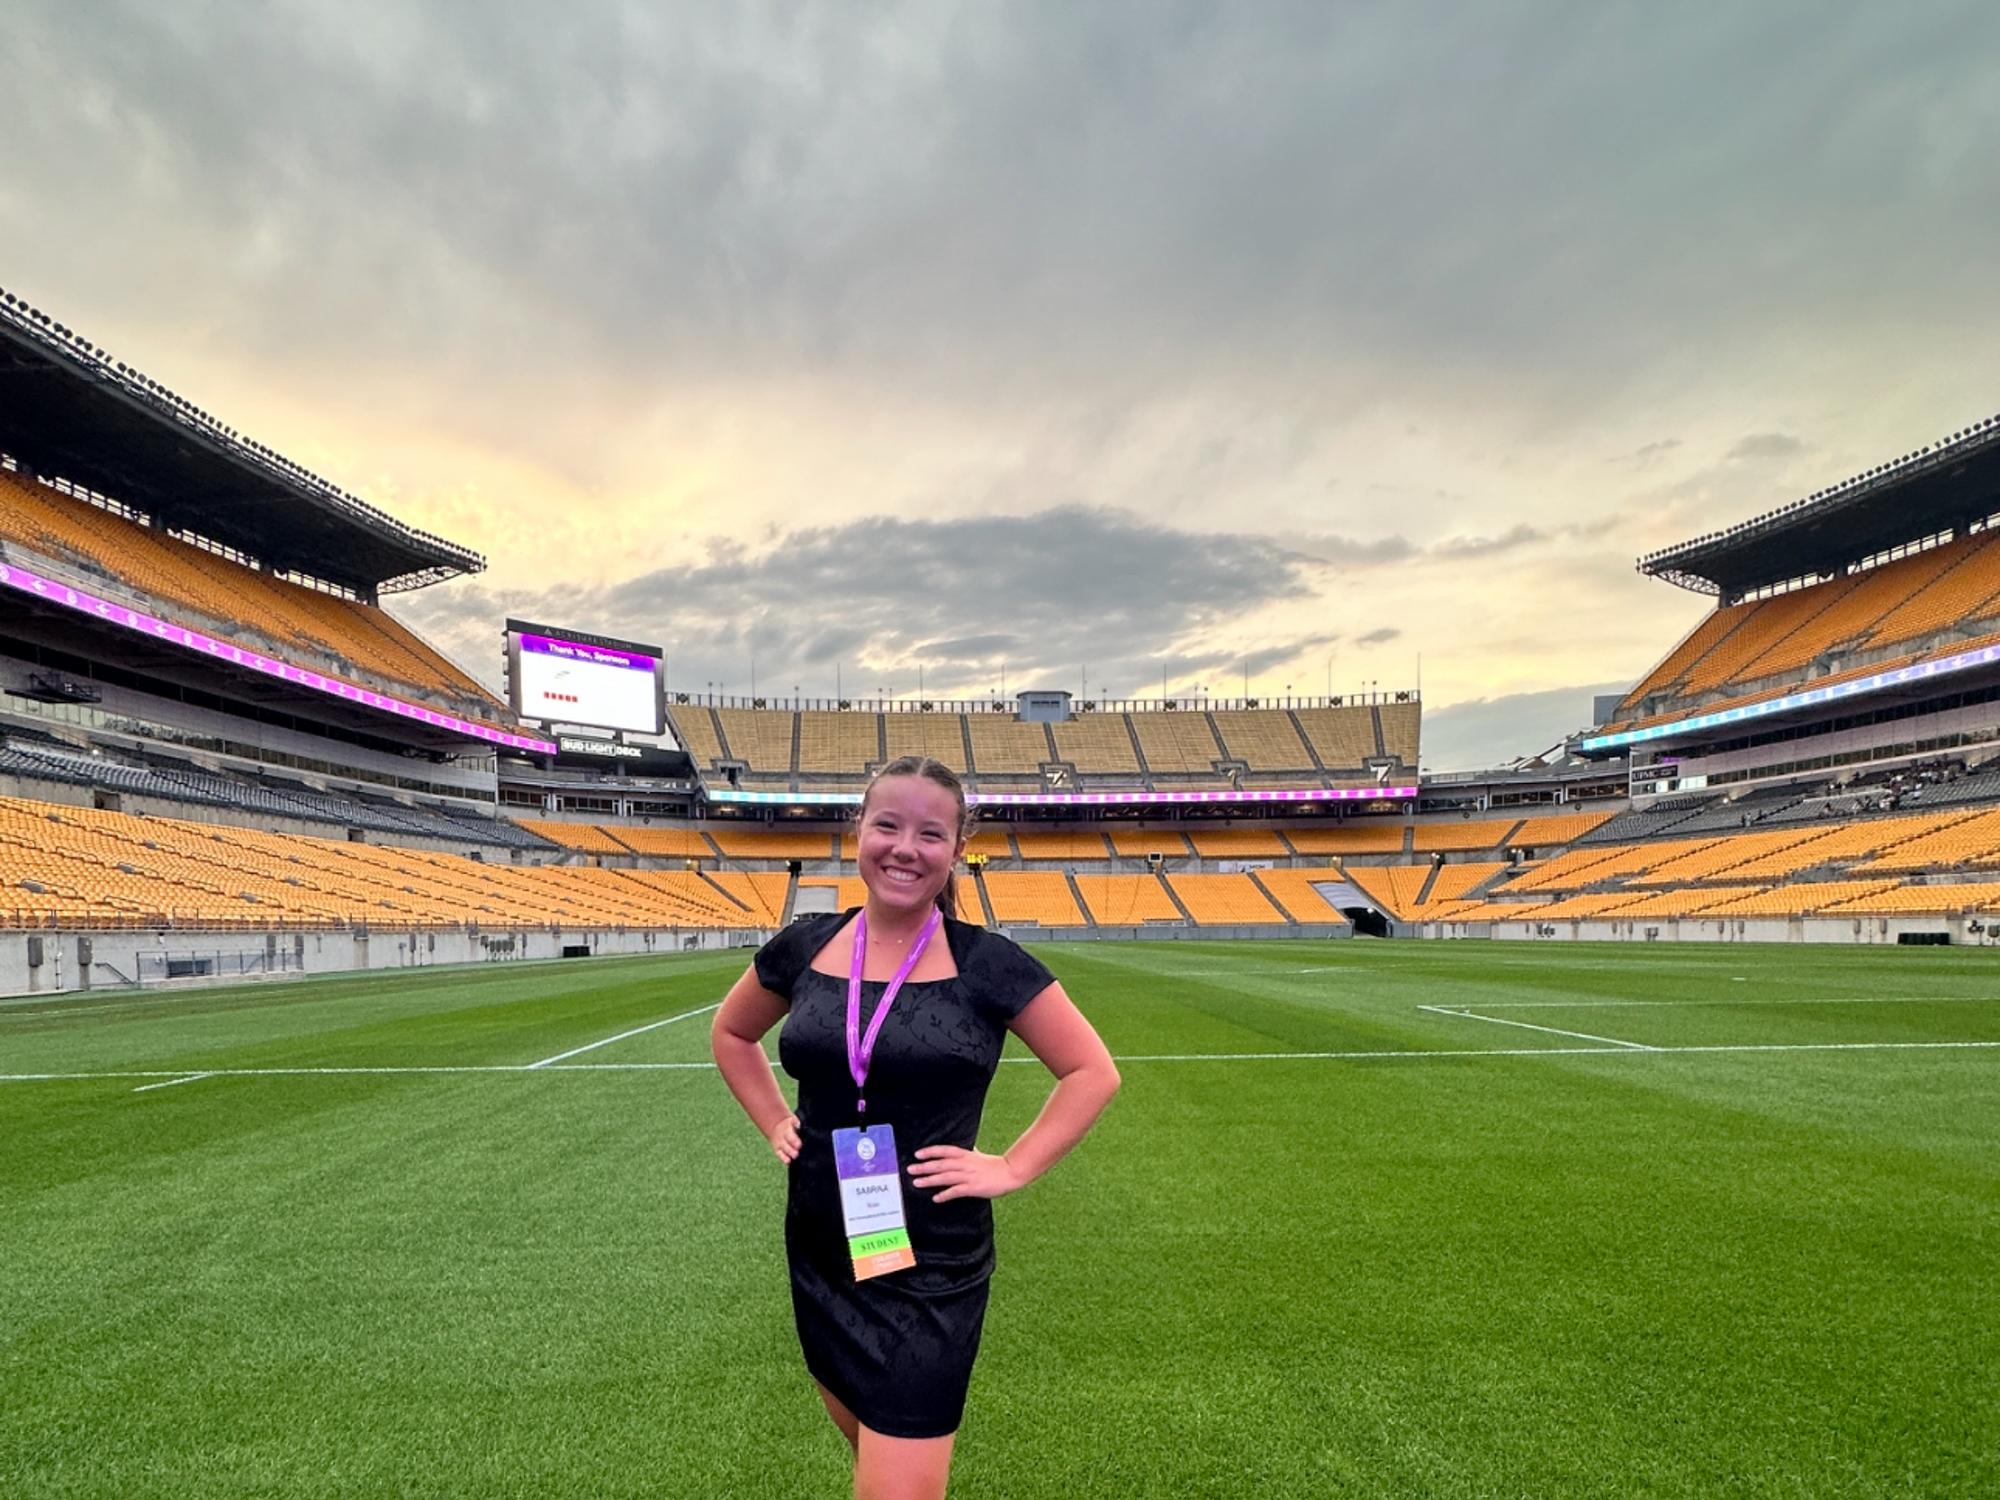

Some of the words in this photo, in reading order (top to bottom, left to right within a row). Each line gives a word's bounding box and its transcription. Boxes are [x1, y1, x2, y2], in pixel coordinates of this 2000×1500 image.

[548, 642, 574, 655] Thank
[593, 651, 630, 665] Sponsors
[562, 739, 583, 751] BUD
[586, 742, 614, 755] LIGHT
[616, 746, 642, 757] DECK
[856, 1184, 888, 1195] SABRINA
[861, 1237, 899, 1251] STUDENT
